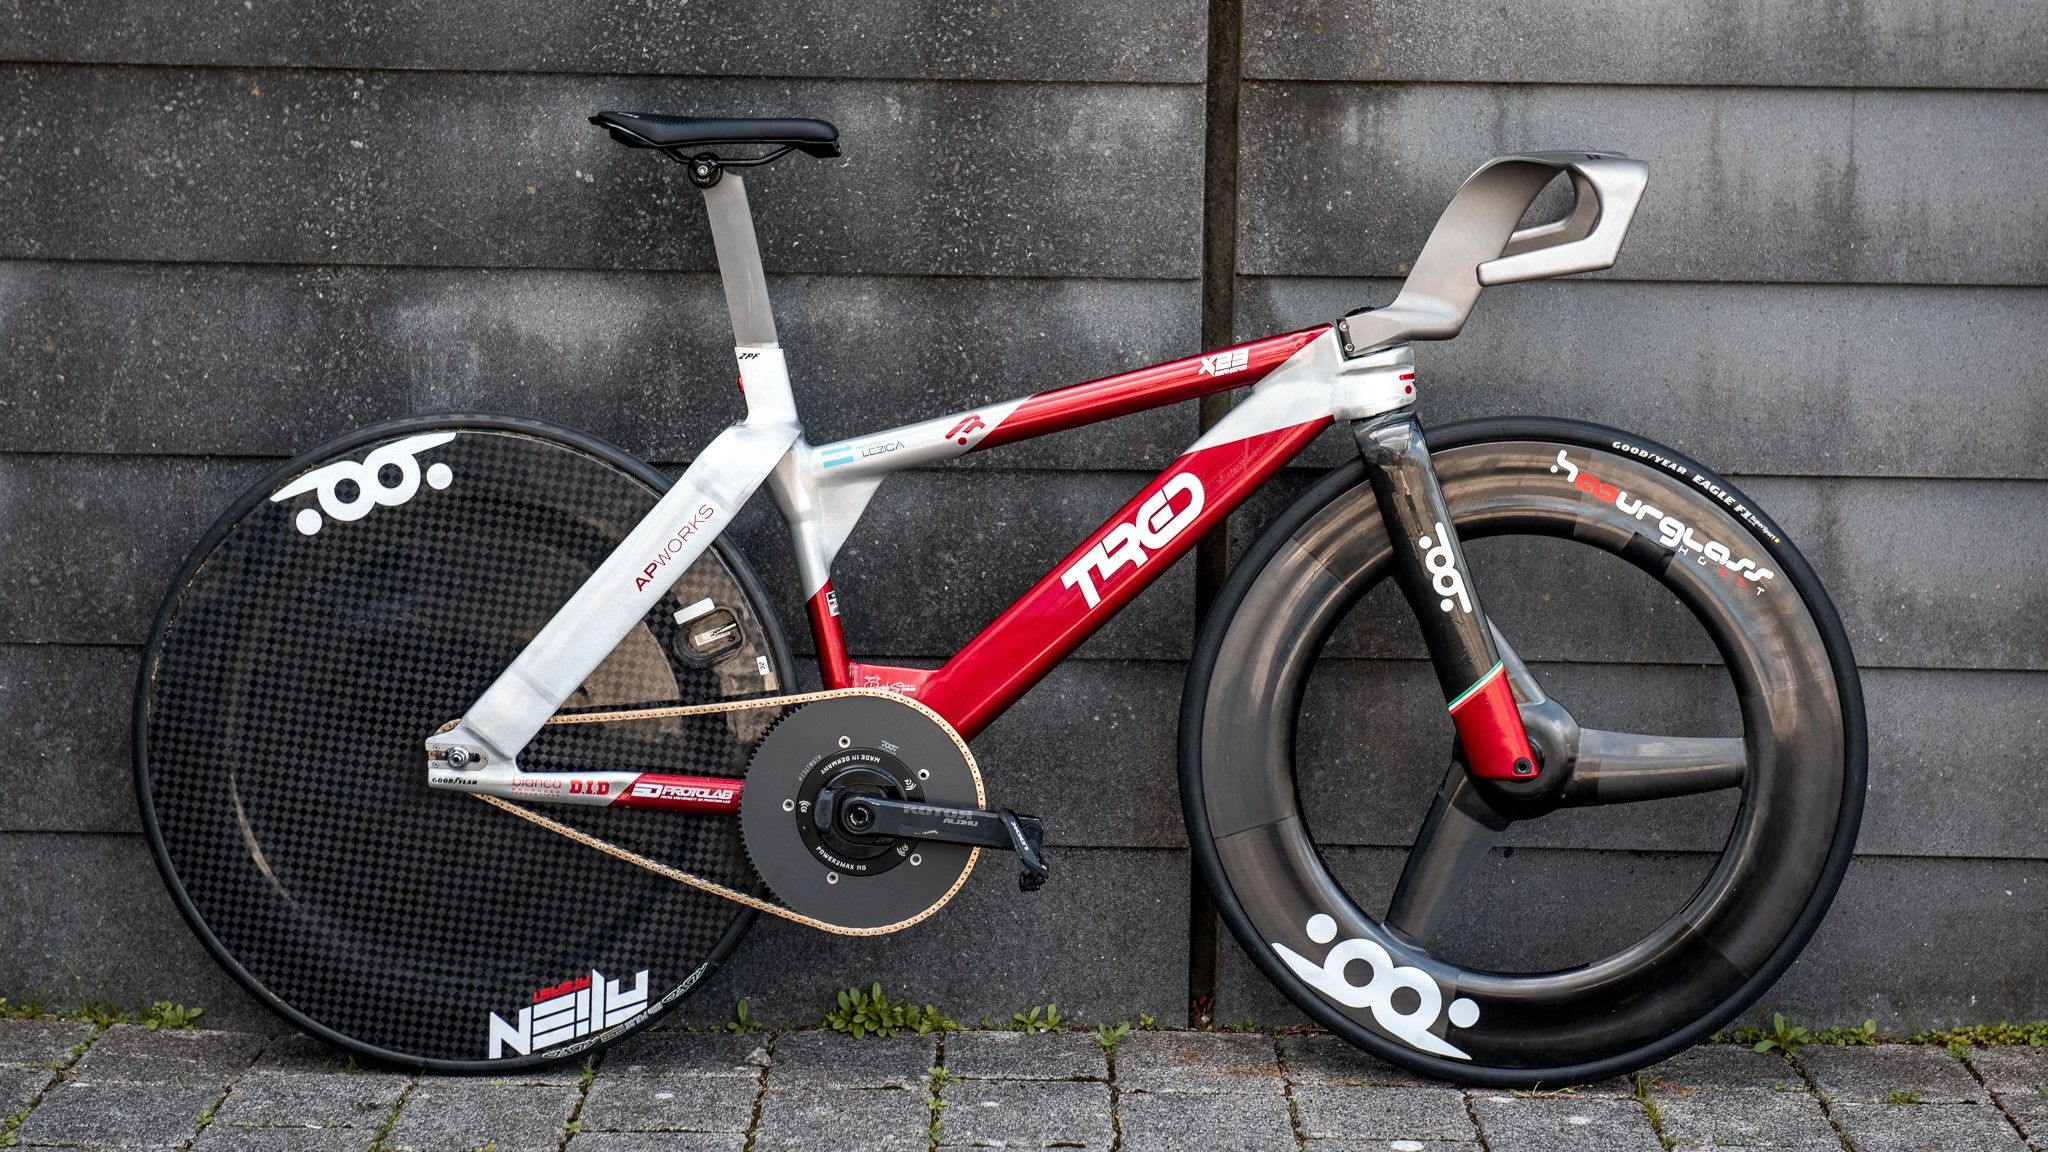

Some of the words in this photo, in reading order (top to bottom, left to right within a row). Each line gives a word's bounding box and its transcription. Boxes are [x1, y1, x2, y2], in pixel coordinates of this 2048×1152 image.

[738, 352, 760, 360] ZPF
[1612, 441, 1687, 475] GOODYEAR
[1692, 474, 1737, 507] EAGLE
[635, 504, 714, 592] APWORKS
[431, 777, 478, 786] GOODYEAR
[815, 845, 855, 870] POWER2MAX
